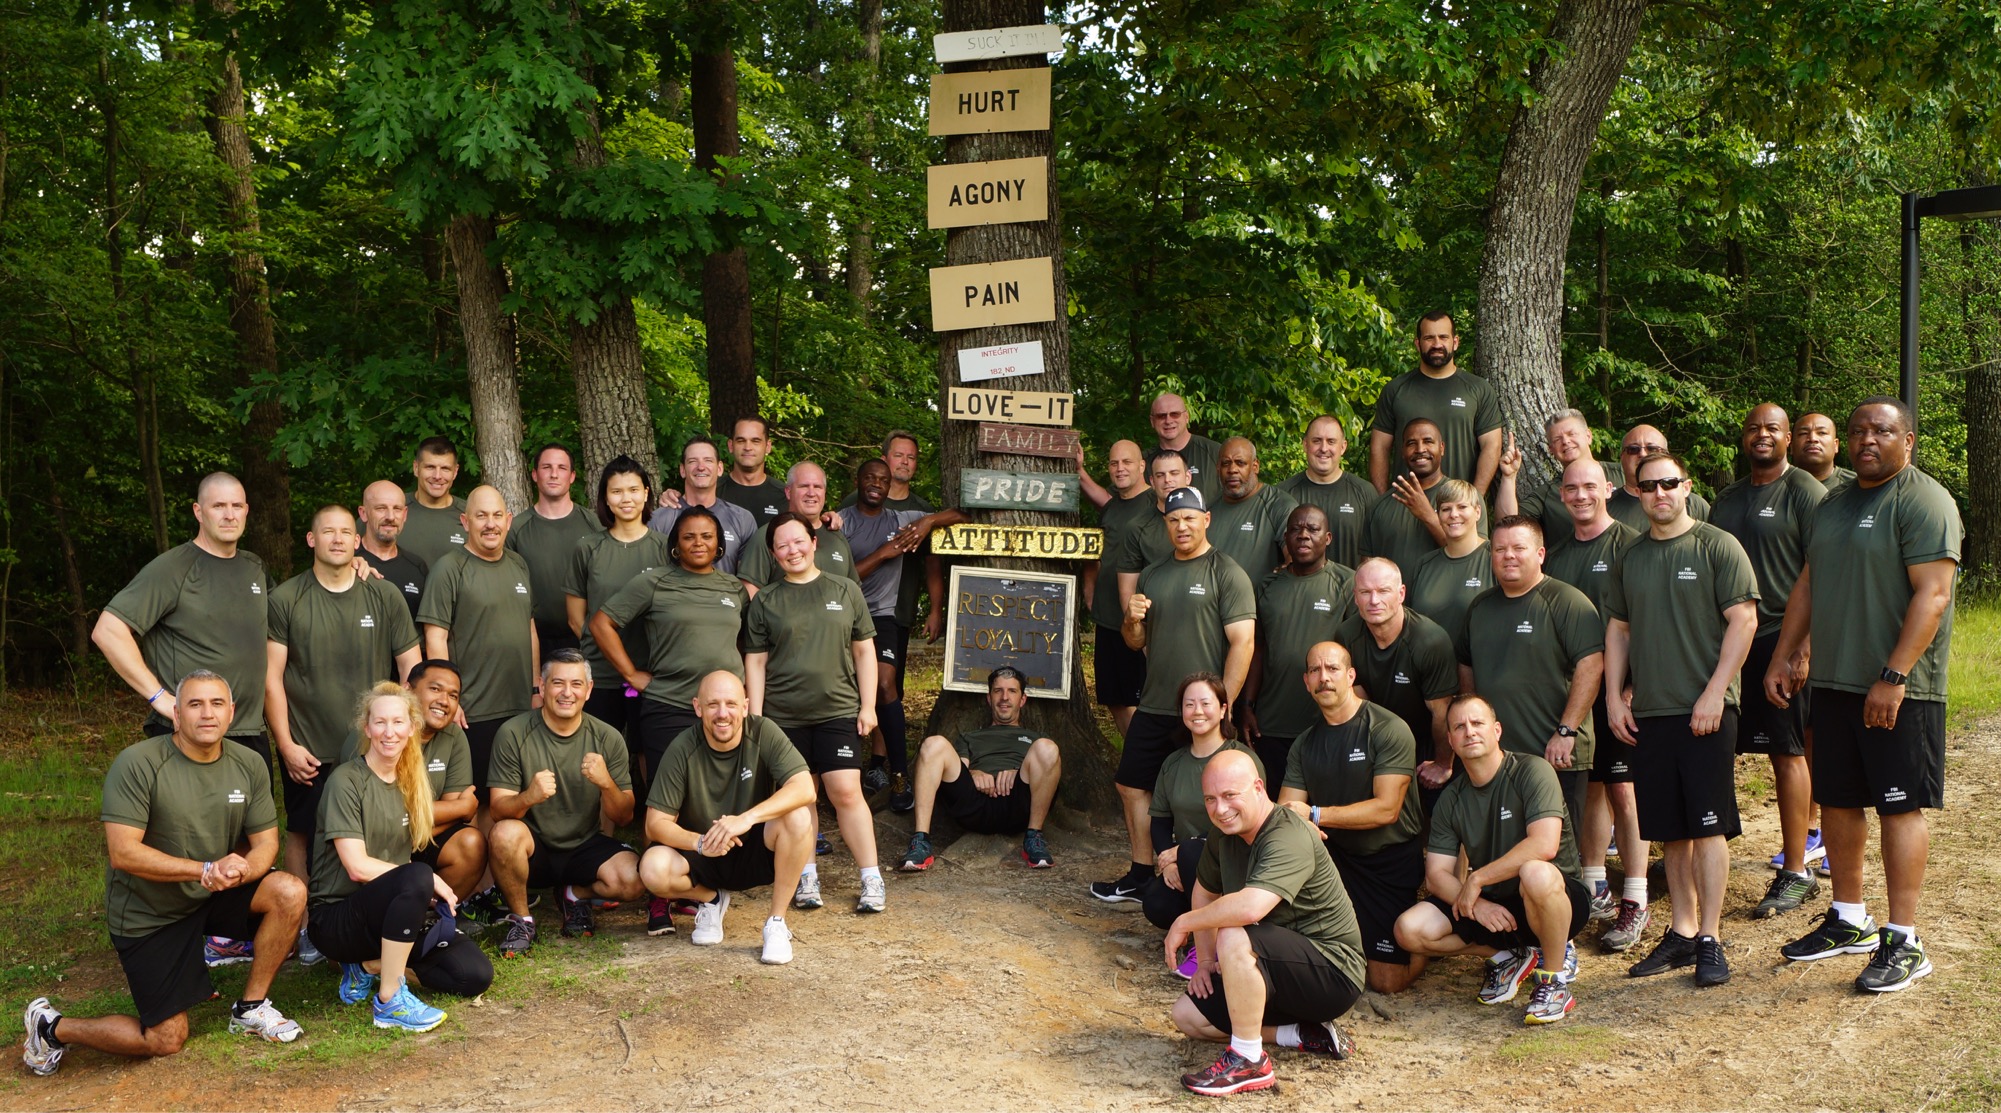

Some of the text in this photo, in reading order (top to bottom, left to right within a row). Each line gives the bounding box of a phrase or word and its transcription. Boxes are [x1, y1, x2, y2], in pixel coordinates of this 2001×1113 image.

[968, 35, 1002, 50] SUCK
[958, 89, 1020, 115] HURT
[949, 178, 1026, 208] AGONY
[964, 280, 1020, 308] PAIN
[981, 346, 1019, 358] INTEGRITY
[983, 427, 1078, 453] FAMILY
[974, 477, 1066, 504] PRIDE
[939, 527, 1100, 555] ATTITUDE
[958, 592, 1064, 622] RESPECT
[960, 625, 1058, 654] LOYALTY
